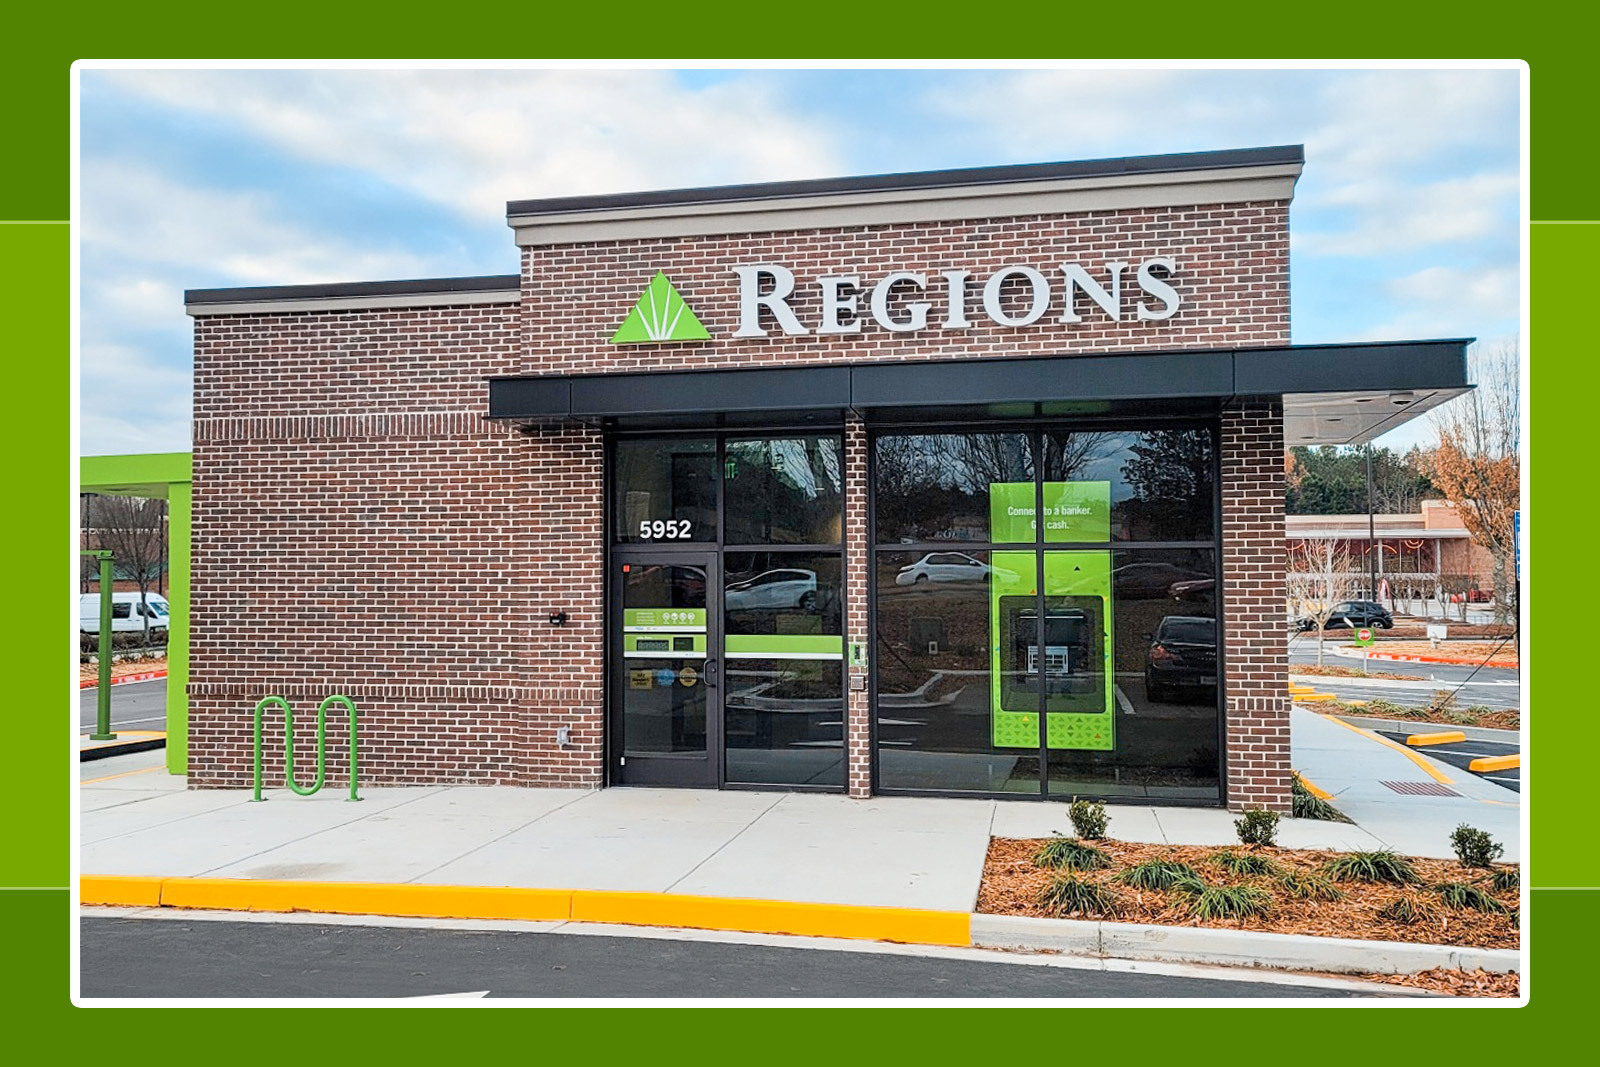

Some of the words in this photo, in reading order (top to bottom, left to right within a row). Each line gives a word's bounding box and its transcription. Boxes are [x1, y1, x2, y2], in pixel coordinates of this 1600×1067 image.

[731, 257, 1182, 340] REGIONS
[1043, 507, 1052, 516] to
[1061, 506, 1092, 516] banker.
[639, 519, 692, 540] 5952
[1046, 520, 1070, 530] cash.
